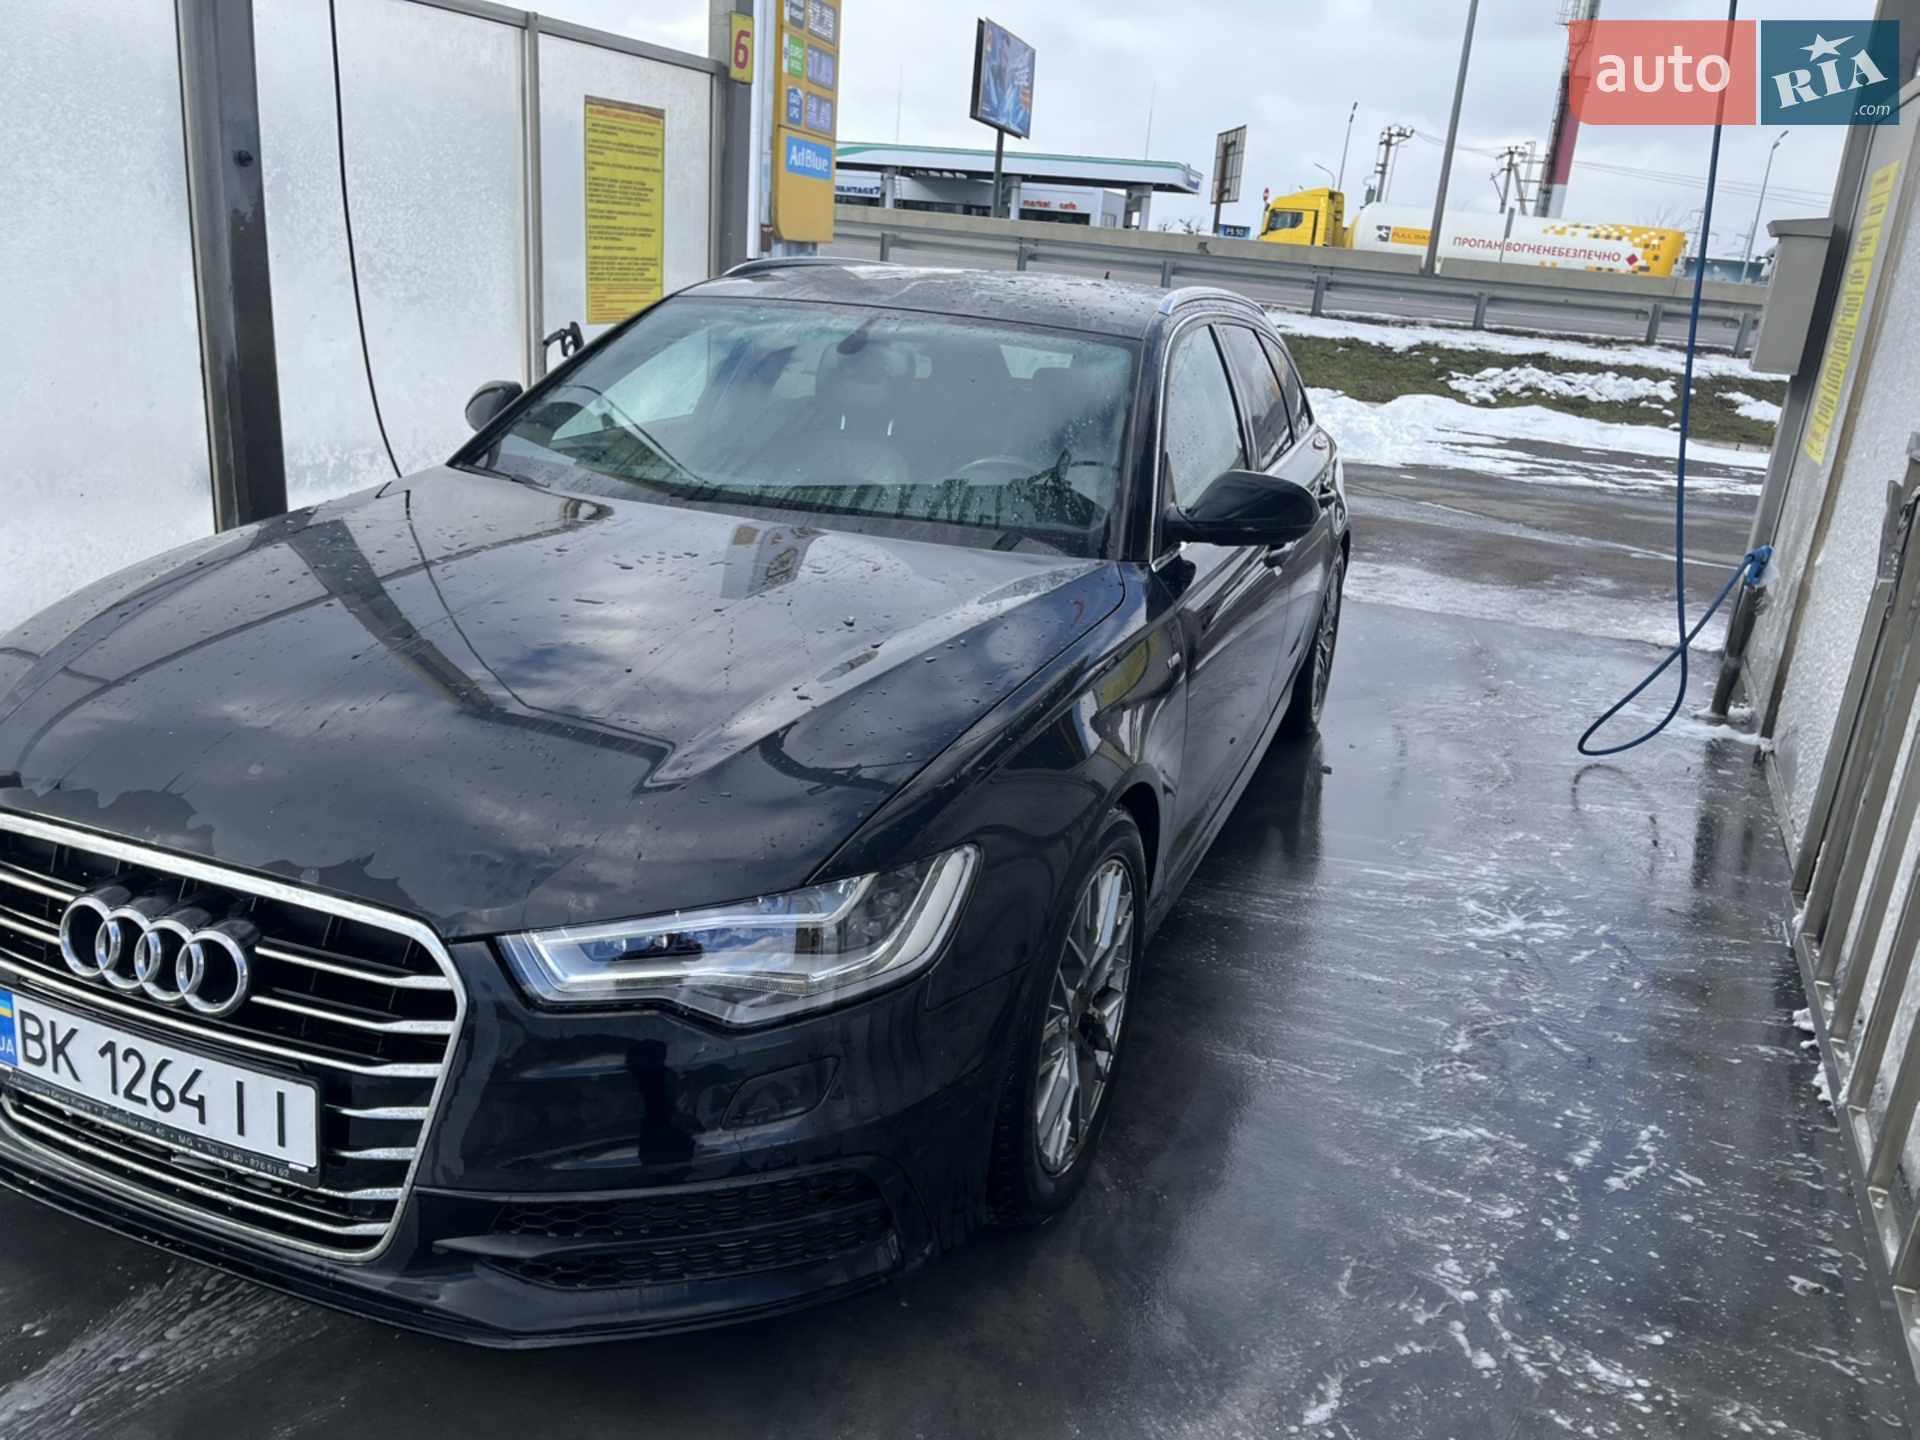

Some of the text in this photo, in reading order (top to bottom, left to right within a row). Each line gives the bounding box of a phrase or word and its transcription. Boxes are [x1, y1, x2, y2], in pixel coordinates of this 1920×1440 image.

[734, 29, 751, 70] 6
[788, 144, 829, 173] AdBlue
[1023, 199, 1078, 211] market cafe
[1452, 236, 1621, 262] ПРОПАН ВОГНЕНЕБЕЗПЕЧНО
[18, 1009, 81, 1083] BK
[97, 1040, 206, 1126] 1264
[178, 1135, 193, 1147] MG
